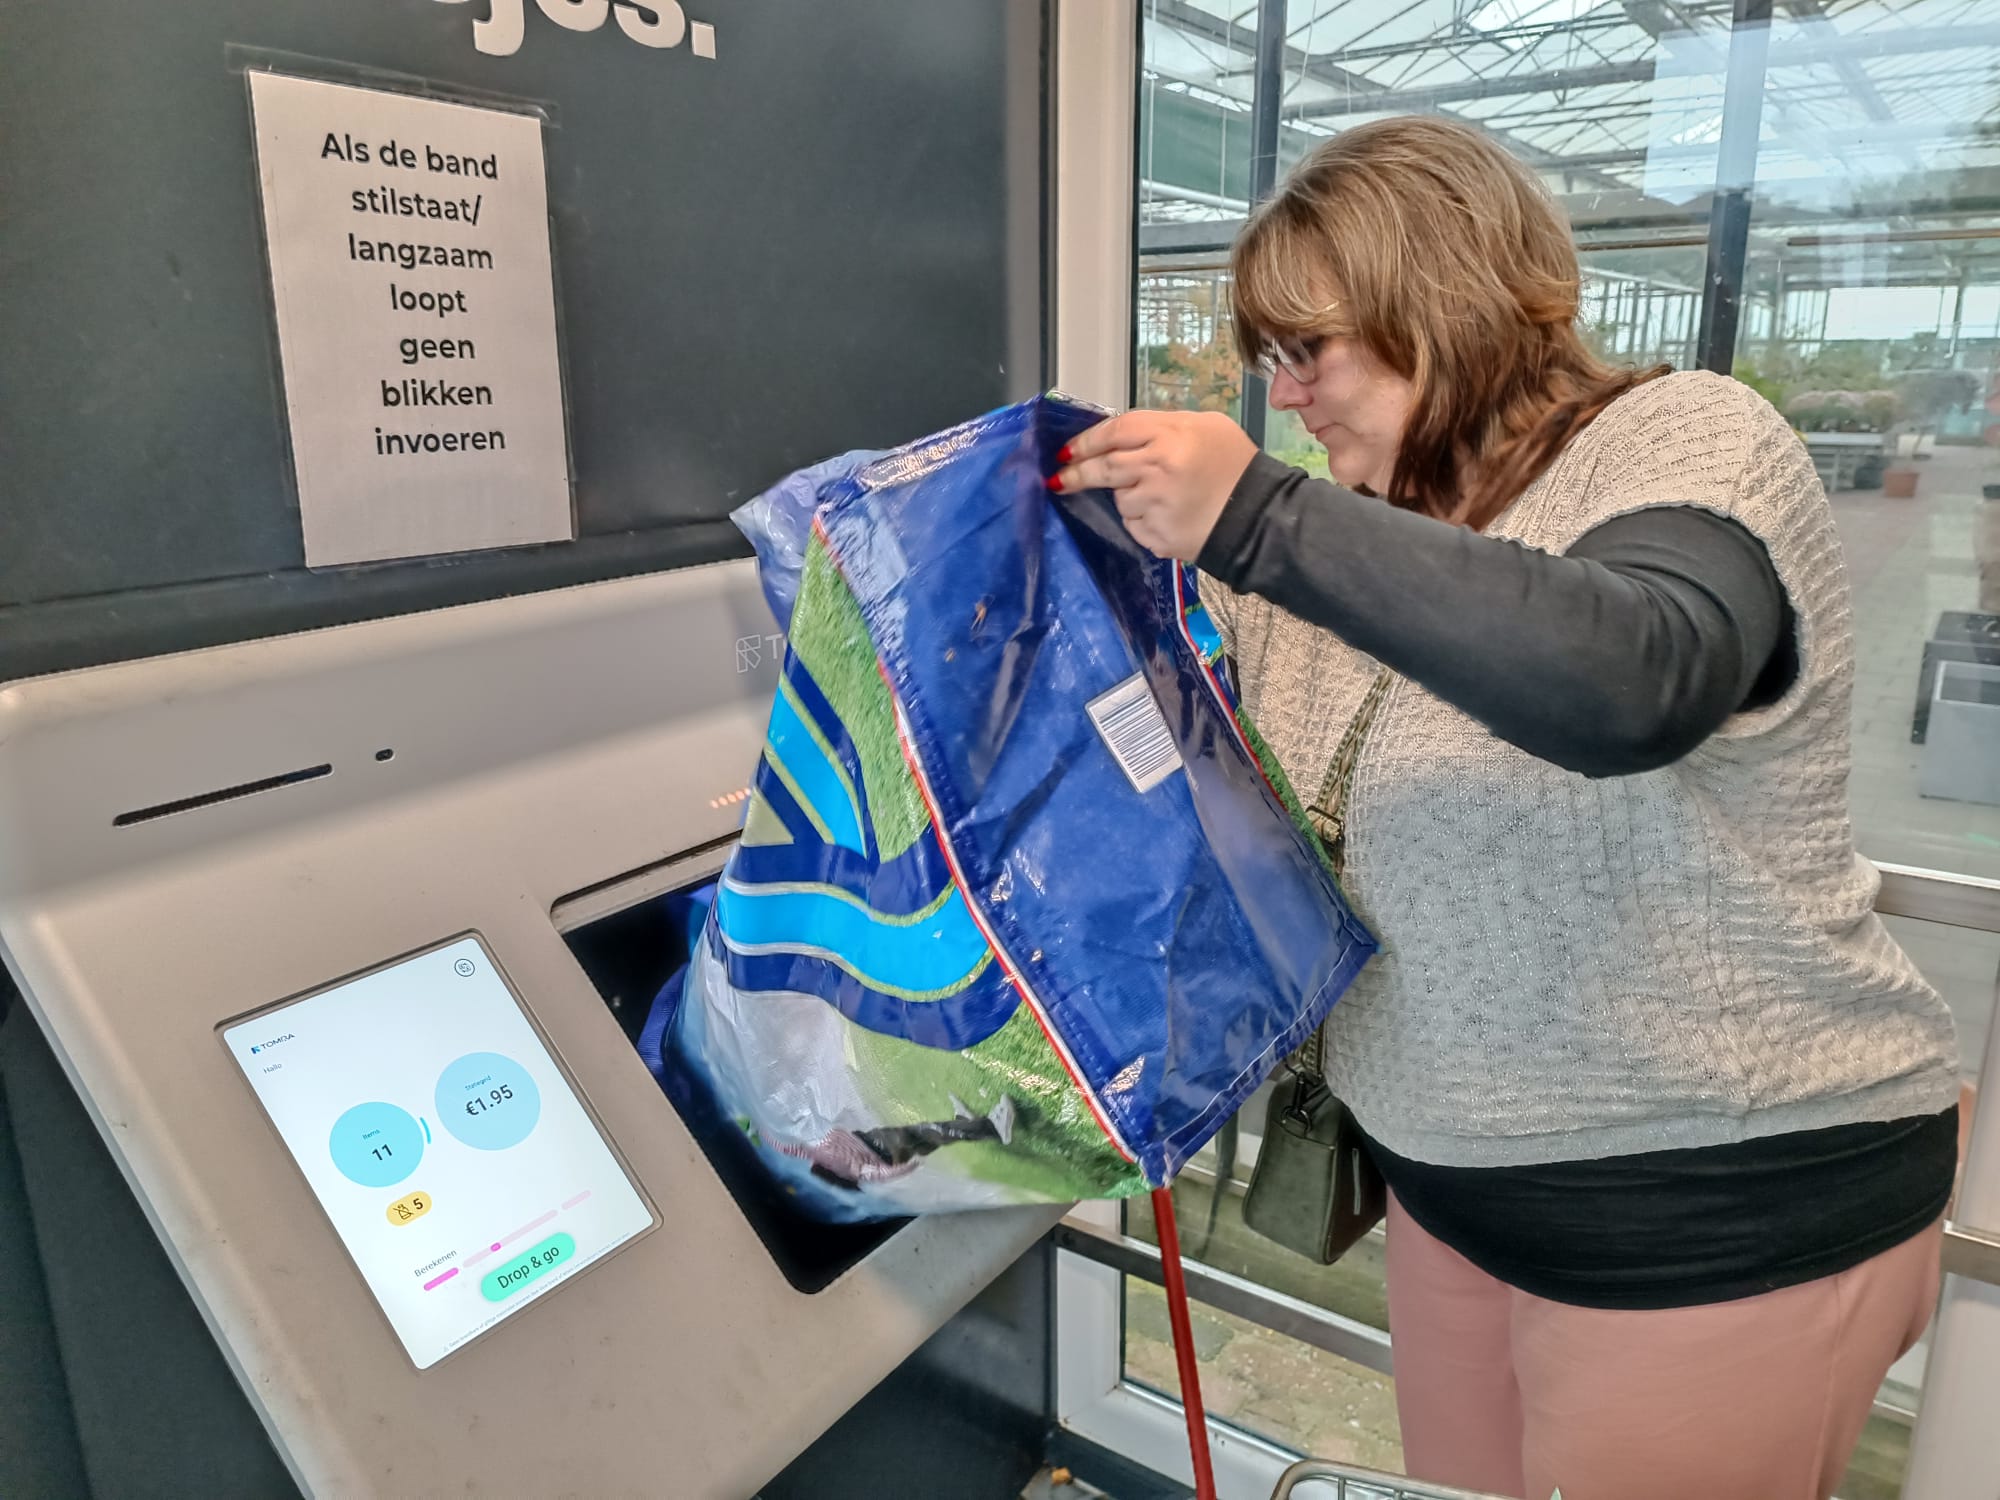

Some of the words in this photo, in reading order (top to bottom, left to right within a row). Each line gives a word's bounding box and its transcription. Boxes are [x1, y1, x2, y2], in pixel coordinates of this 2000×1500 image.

[321, 132, 371, 164] Als
[379, 139, 417, 169] de
[426, 144, 498, 180] band
[351, 185, 482, 226] stilstaat/
[348, 232, 493, 270] langzaam
[390, 283, 467, 318] loopt
[399, 338, 475, 365] geen
[381, 378, 493, 407] blikken
[375, 427, 506, 455] invoeren
[465, 1083, 513, 1116] €1.95
[371, 1143, 393, 1161] 11
[412, 1197, 424, 1210] 5
[414, 1249, 457, 1278] Berekenen
[497, 1264, 530, 1289] Drop
[530, 1255, 543, 1269] &
[542, 1246, 560, 1265] go
